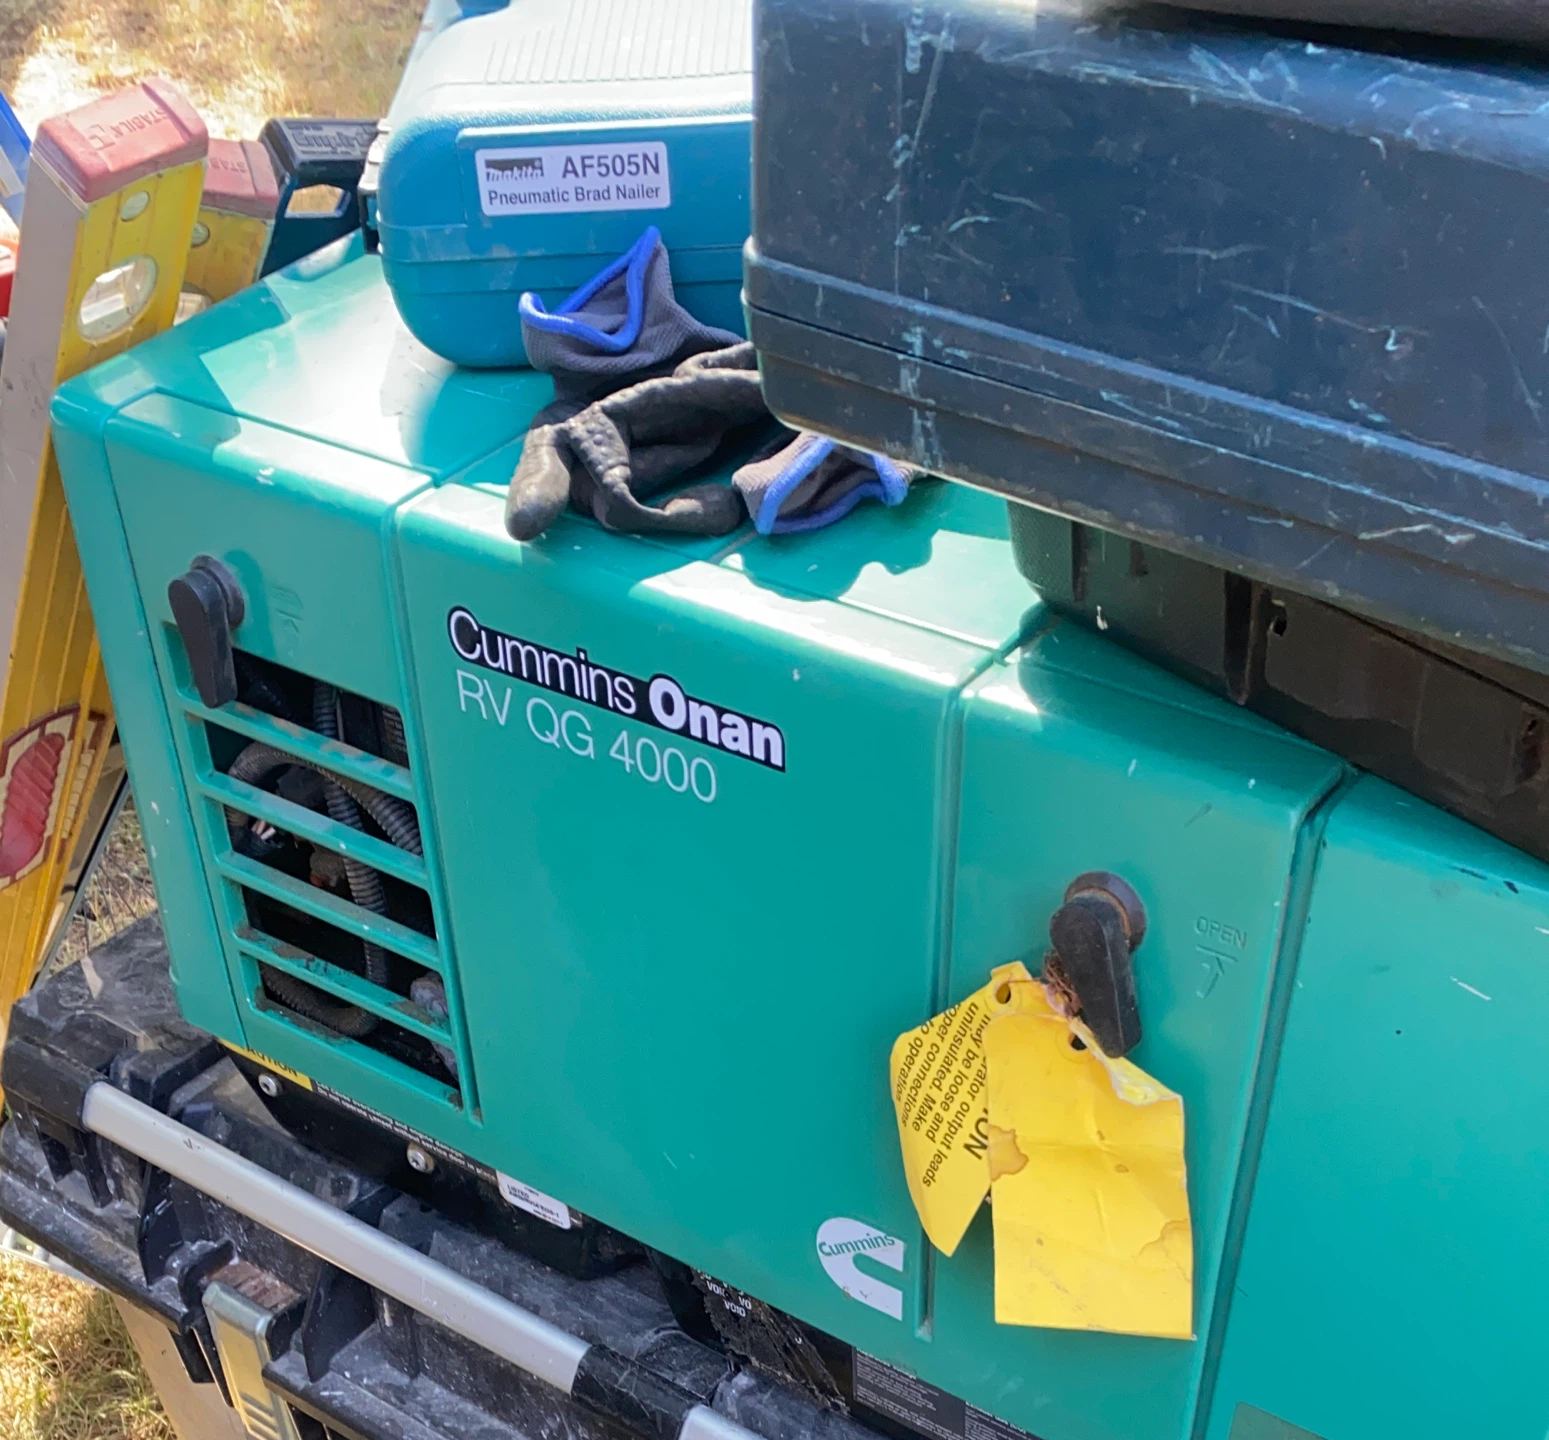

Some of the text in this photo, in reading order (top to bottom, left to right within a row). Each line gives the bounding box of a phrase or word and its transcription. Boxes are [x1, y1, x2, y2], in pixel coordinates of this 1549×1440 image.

[562, 152, 660, 179] AF505N
[488, 184, 661, 206] Pneumatic Brad Nailer
[450, 610, 783, 767] Cummins Onan
[456, 670, 717, 804] RV QG 4000
[1196, 916, 1248, 948] OPEN
[895, 1037, 923, 1103] operation
[912, 1002, 979, 1132] uninsulated. Make
[961, 1048, 979, 1069] be
[902, 1042, 940, 1127] connections
[940, 1069, 969, 1112] loose
[925, 1113, 944, 1144] and
[940, 1101, 970, 1151] output
[922, 1149, 948, 1187] leads
[818, 1232, 895, 1257] Cummins
[723, 1299, 746, 1317] VOID
